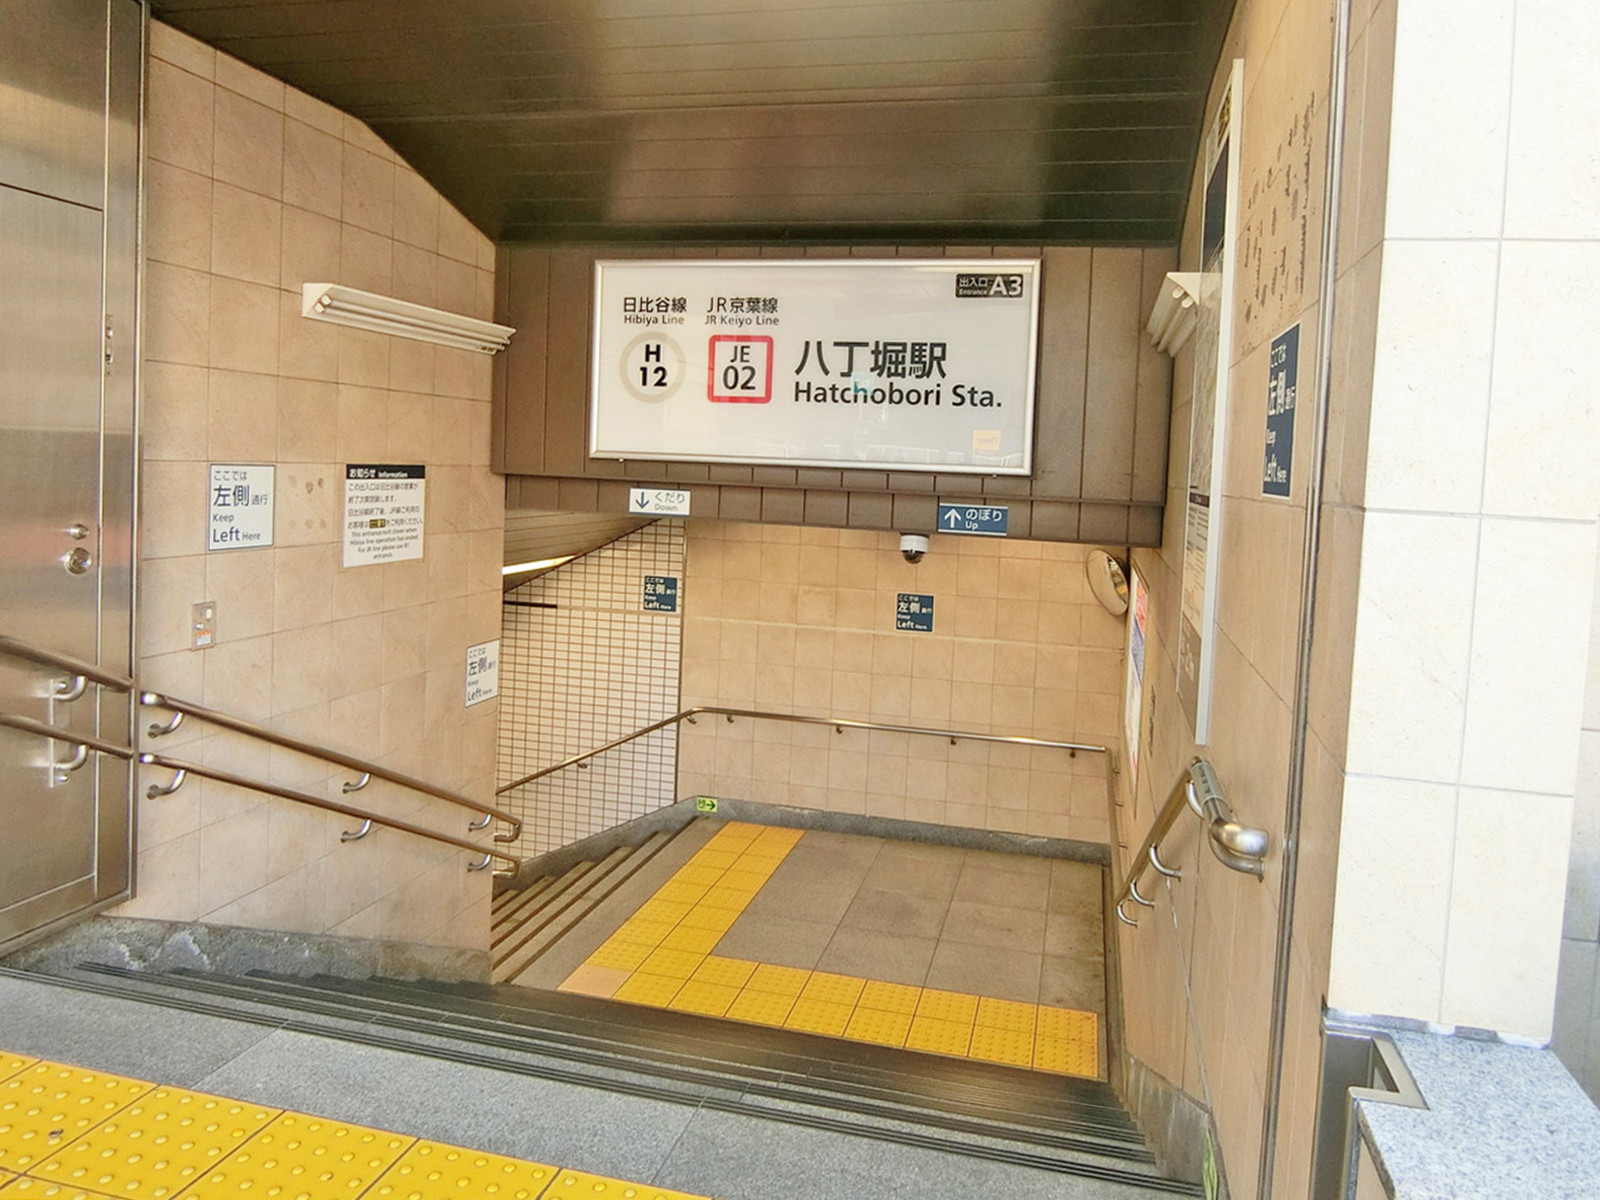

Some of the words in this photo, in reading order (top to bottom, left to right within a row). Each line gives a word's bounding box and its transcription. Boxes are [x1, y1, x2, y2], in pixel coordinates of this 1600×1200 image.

[960, 277, 988, 287] 出入口
[989, 276, 1022, 295] A3
[623, 297, 687, 313] 日比谷線
[624, 315, 658, 326] Hibiya
[662, 315, 685, 325] Line
[705, 315, 717, 325] JR
[720, 315, 752, 327] Keiyo
[756, 316, 780, 326] Line
[645, 344, 661, 362] H
[730, 346, 750, 363] JE
[794, 340, 947, 379] 八丁堀駅
[640, 366, 668, 387] 12
[723, 365, 756, 390] 02
[794, 381, 941, 406] Hatchobori
[952, 384, 1002, 407] Sta.
[214, 470, 247, 481] ここでは
[655, 492, 685, 503] くだり
[655, 503, 678, 511] Down
[213, 514, 235, 523] Keep
[966, 509, 1002, 522] のぼり
[965, 521, 979, 530] Up
[213, 526, 240, 543] Left
[242, 532, 261, 541] Here
